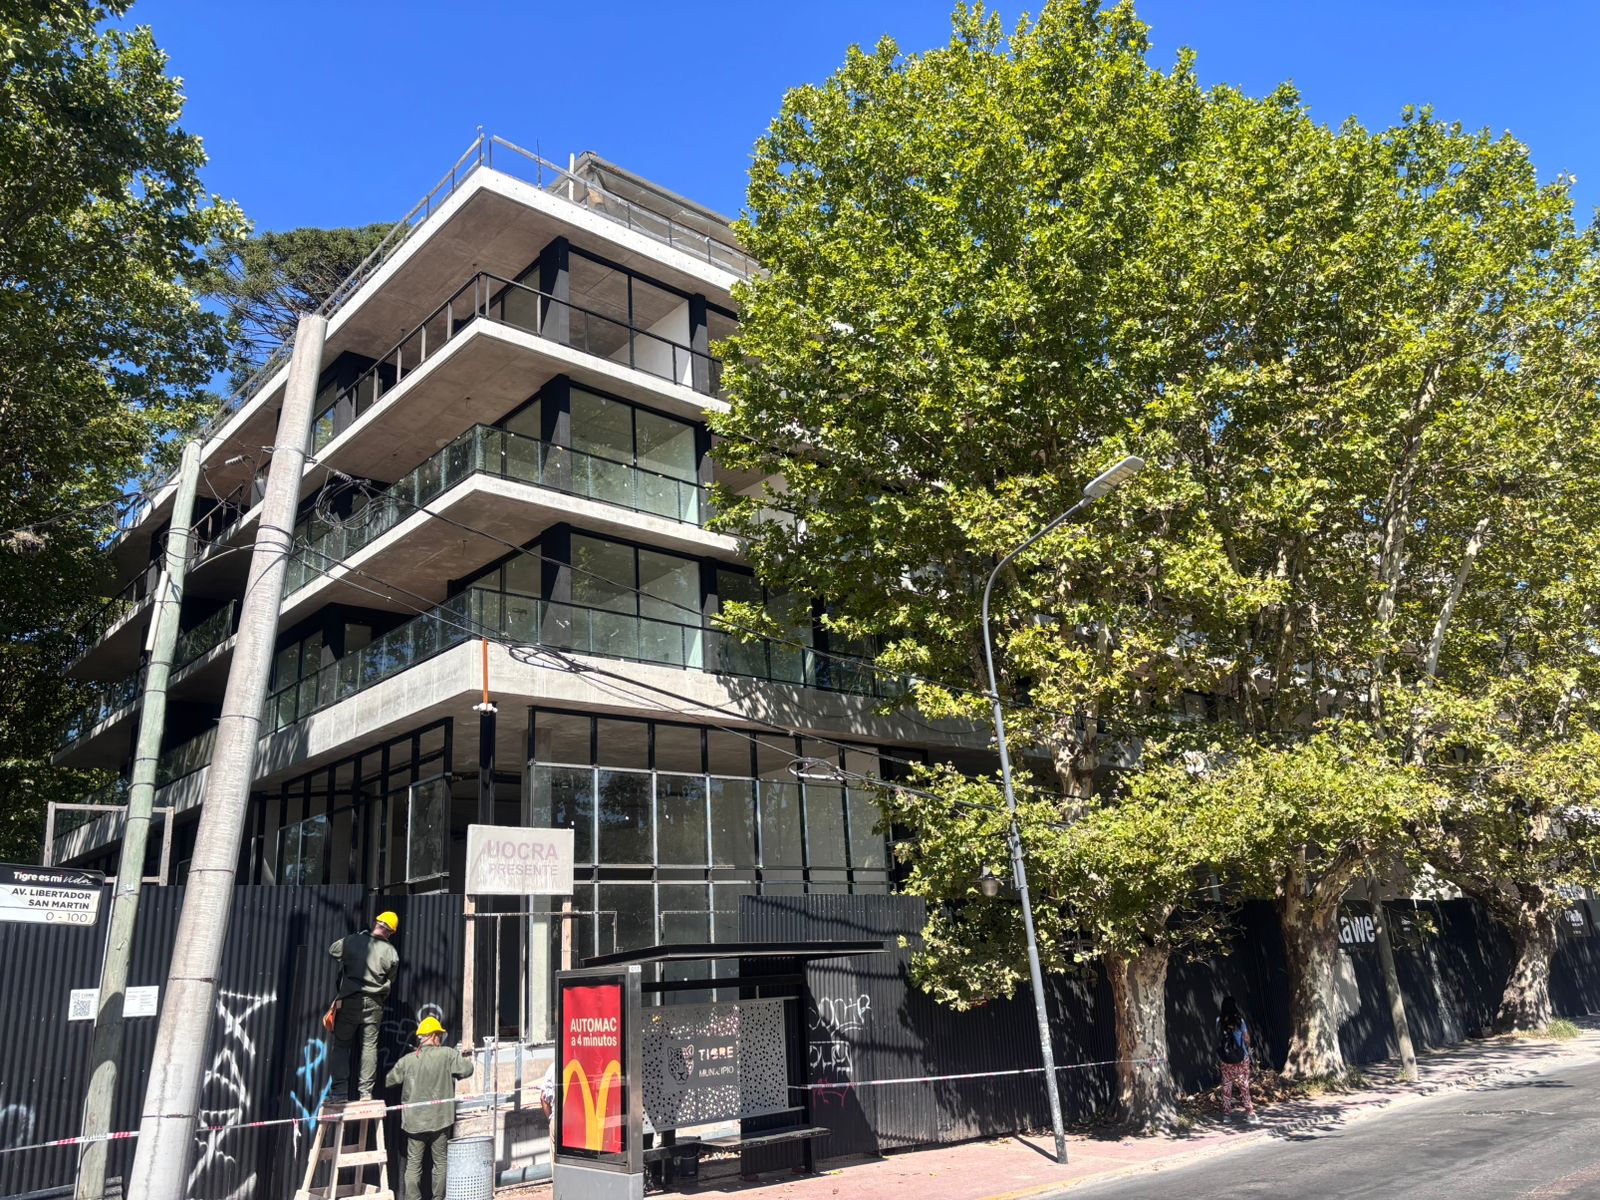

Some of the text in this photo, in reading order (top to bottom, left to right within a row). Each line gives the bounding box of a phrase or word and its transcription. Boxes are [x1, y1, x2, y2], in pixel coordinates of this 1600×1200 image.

[485, 840, 558, 860] UOCRA
[489, 863, 559, 876] PRESENTE
[13, 869, 94, 886] Tigre es mi vida
[11, 888, 92, 900] AV. LIBERTADOR
[28, 899, 90, 910] SAN MARTIN
[45, 911, 55, 921] 0
[67, 912, 88, 923] 100
[1337, 916, 1376, 943] awe
[570, 1017, 617, 1032] AUTOMAC
[571, 1032, 617, 1046] a 4 minutos
[698, 1046, 734, 1061] TIGRE
